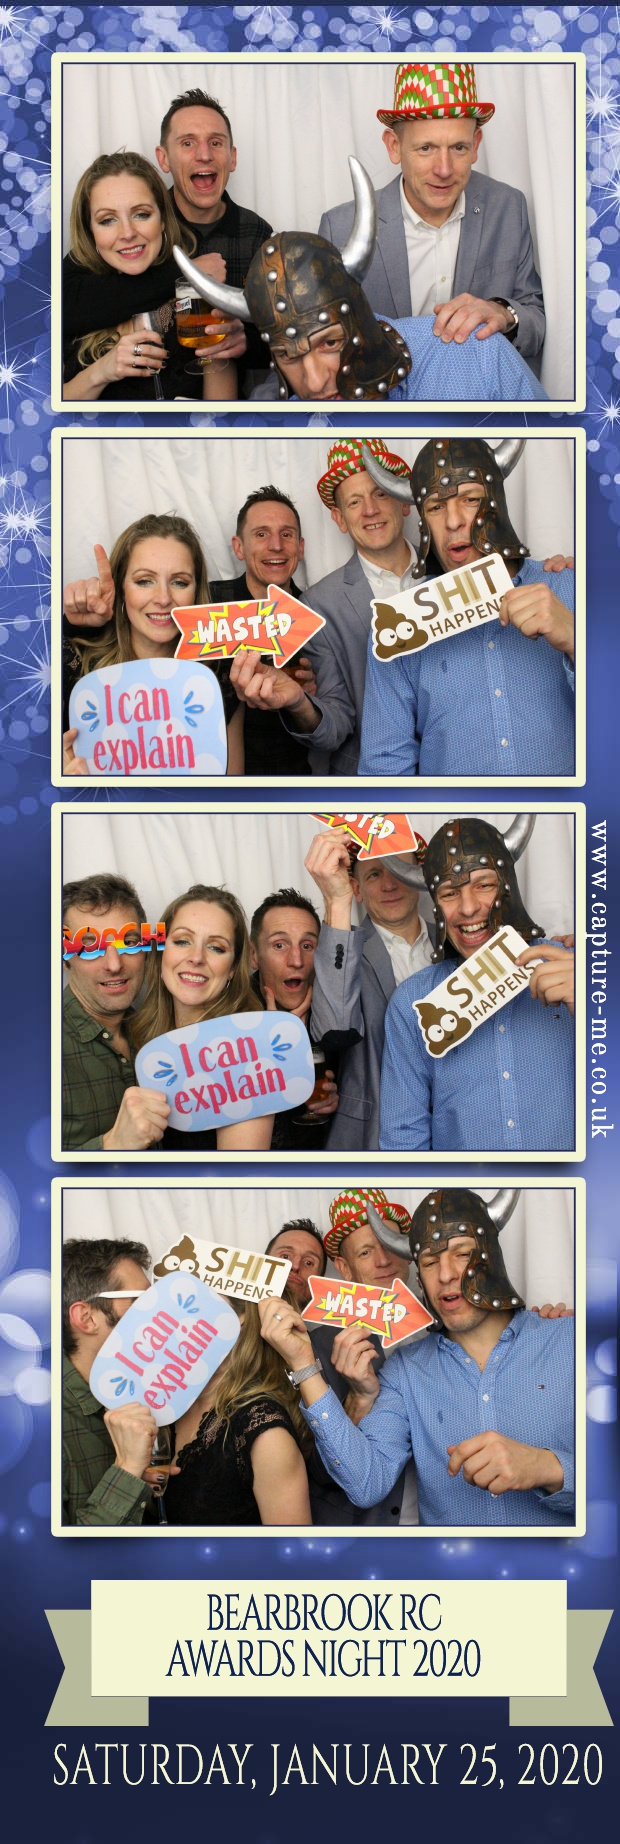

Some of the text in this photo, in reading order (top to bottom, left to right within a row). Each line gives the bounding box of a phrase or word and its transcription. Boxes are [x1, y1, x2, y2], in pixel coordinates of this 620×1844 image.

[413, 559, 497, 621] SHIT
[197, 613, 292, 644] WASTED
[104, 684, 171, 726] I can
[93, 723, 196, 775] explain
[446, 931, 518, 1009] SHIT
[179, 1036, 259, 1078] I can
[174, 1062, 287, 1114] explain
[203, 1274, 274, 1300] HAPPENS
[205, 1247, 286, 1285] SHIT
[325, 1291, 407, 1324] WASTED
[114, 1310, 180, 1377] I can
[143, 1318, 219, 1410] explain
